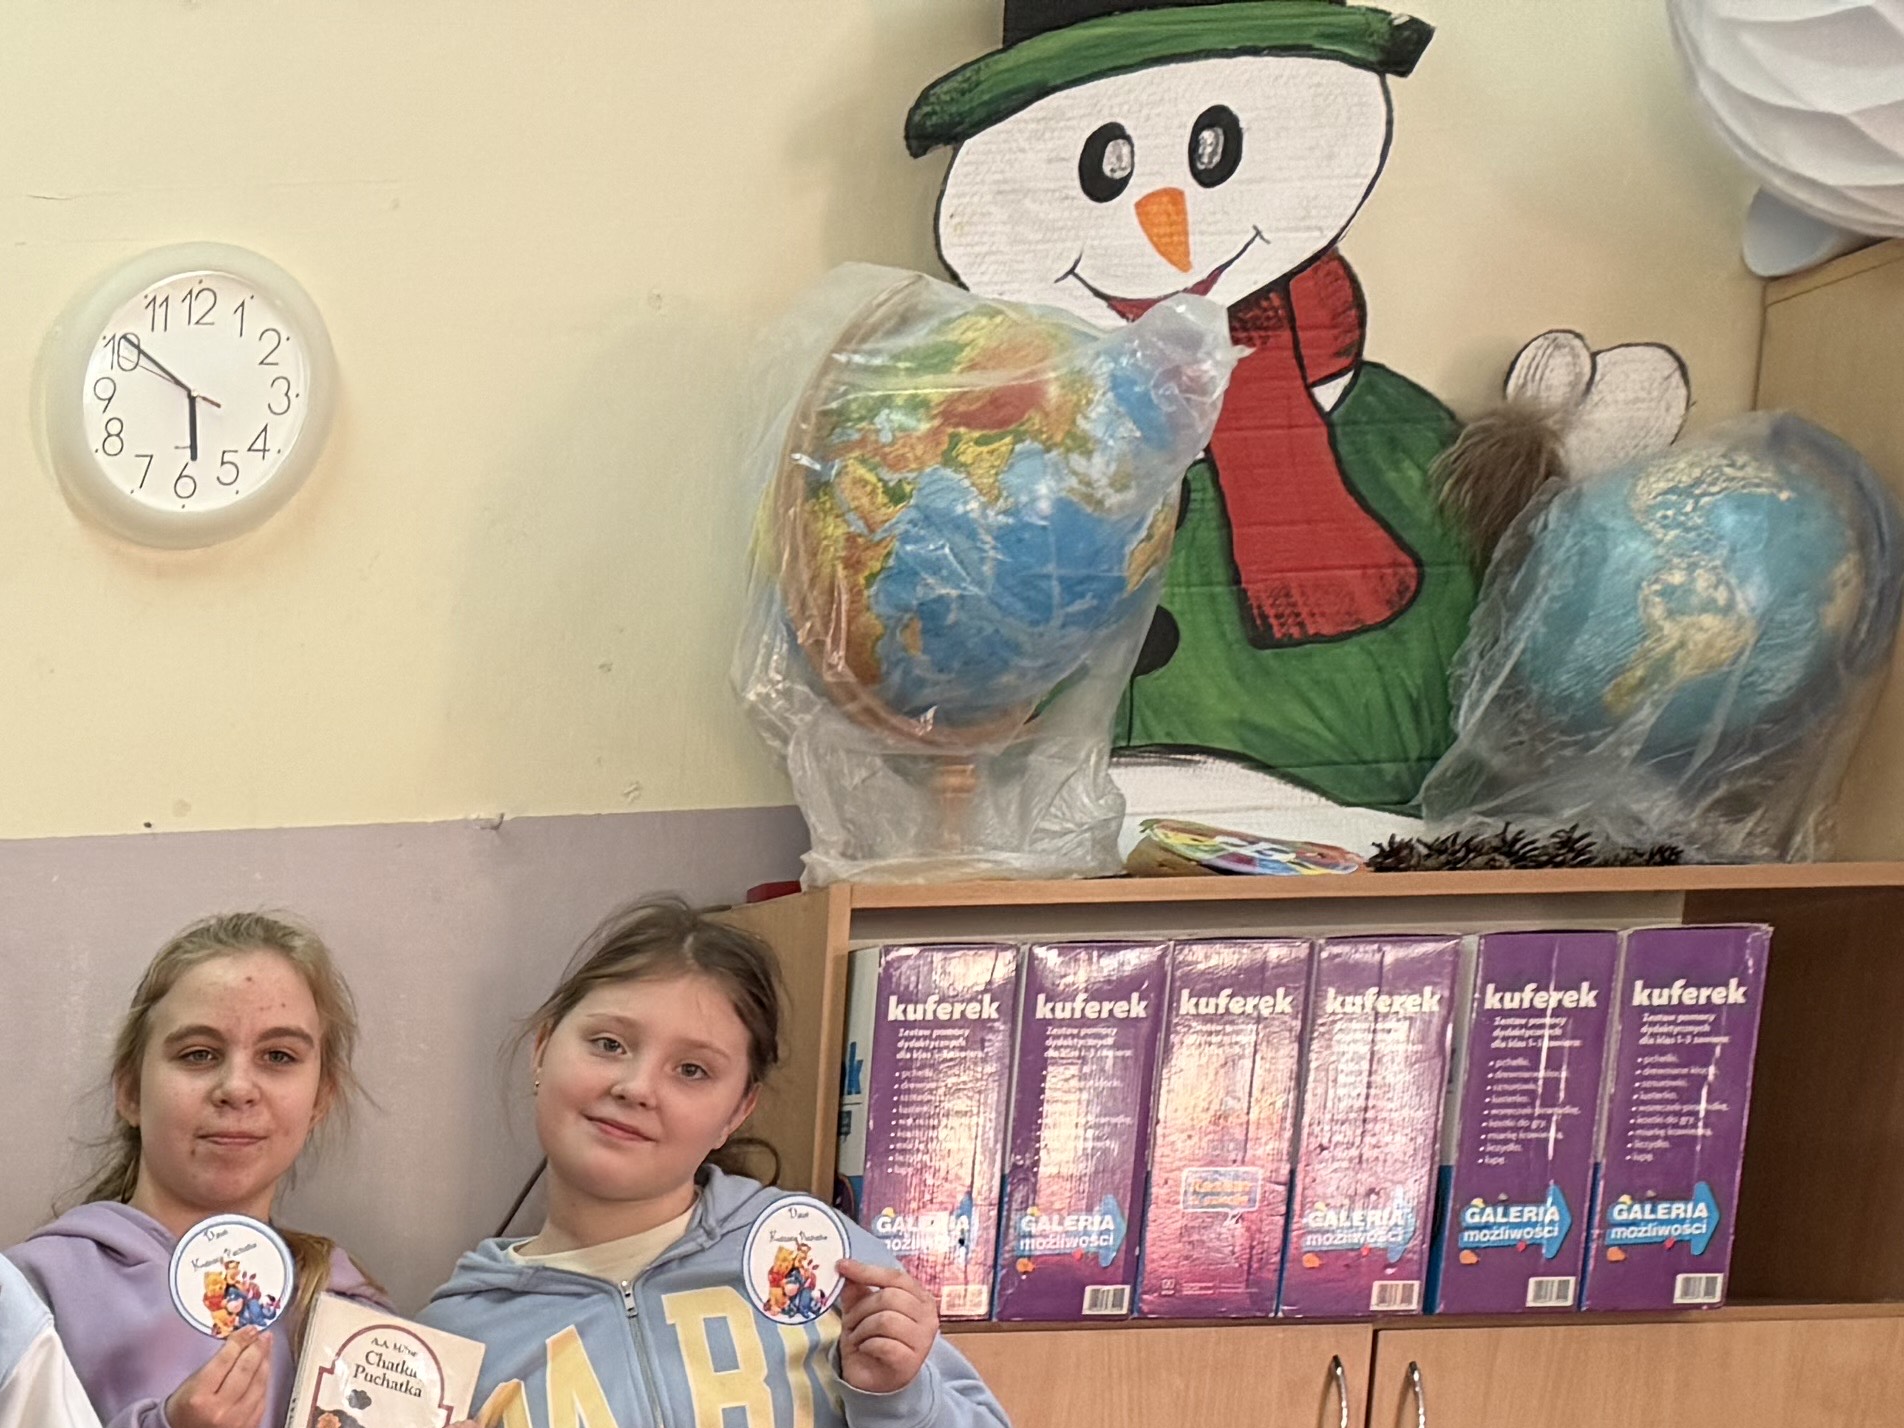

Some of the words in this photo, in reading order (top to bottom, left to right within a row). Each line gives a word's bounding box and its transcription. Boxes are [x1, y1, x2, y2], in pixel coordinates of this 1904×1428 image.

[145, 295, 170, 332] 11
[181, 287, 217, 326] 12
[233, 299, 245, 337] 1
[103, 333, 141, 372] 10
[258, 328, 282, 366] 2
[93, 377, 117, 413] 9
[268, 376, 291, 416] 3
[102, 417, 124, 456] 8
[246, 423, 271, 460] 4
[134, 454, 154, 489] 7
[174, 461, 197, 499] 6
[217, 450, 240, 486] 5
[887, 992, 1001, 1022] kuferek
[1035, 991, 1148, 1020] kuferek
[1179, 987, 1294, 1017] kuferek
[1325, 986, 1442, 1015] kuferek
[1484, 981, 1600, 1009] kuferek
[1632, 977, 1748, 1006] kuferek
[1021, 1214, 1116, 1233] GALERIA
[1308, 1209, 1407, 1229] GALERIA
[1465, 1206, 1560, 1223] GALERIA
[1612, 1202, 1708, 1220] GALERIA
[1463, 1223, 1558, 1241] możliwości
[1611, 1221, 1707, 1239] możliwości
[365, 1350, 417, 1378] Chatka
[353, 1363, 422, 1398] Puchatka
